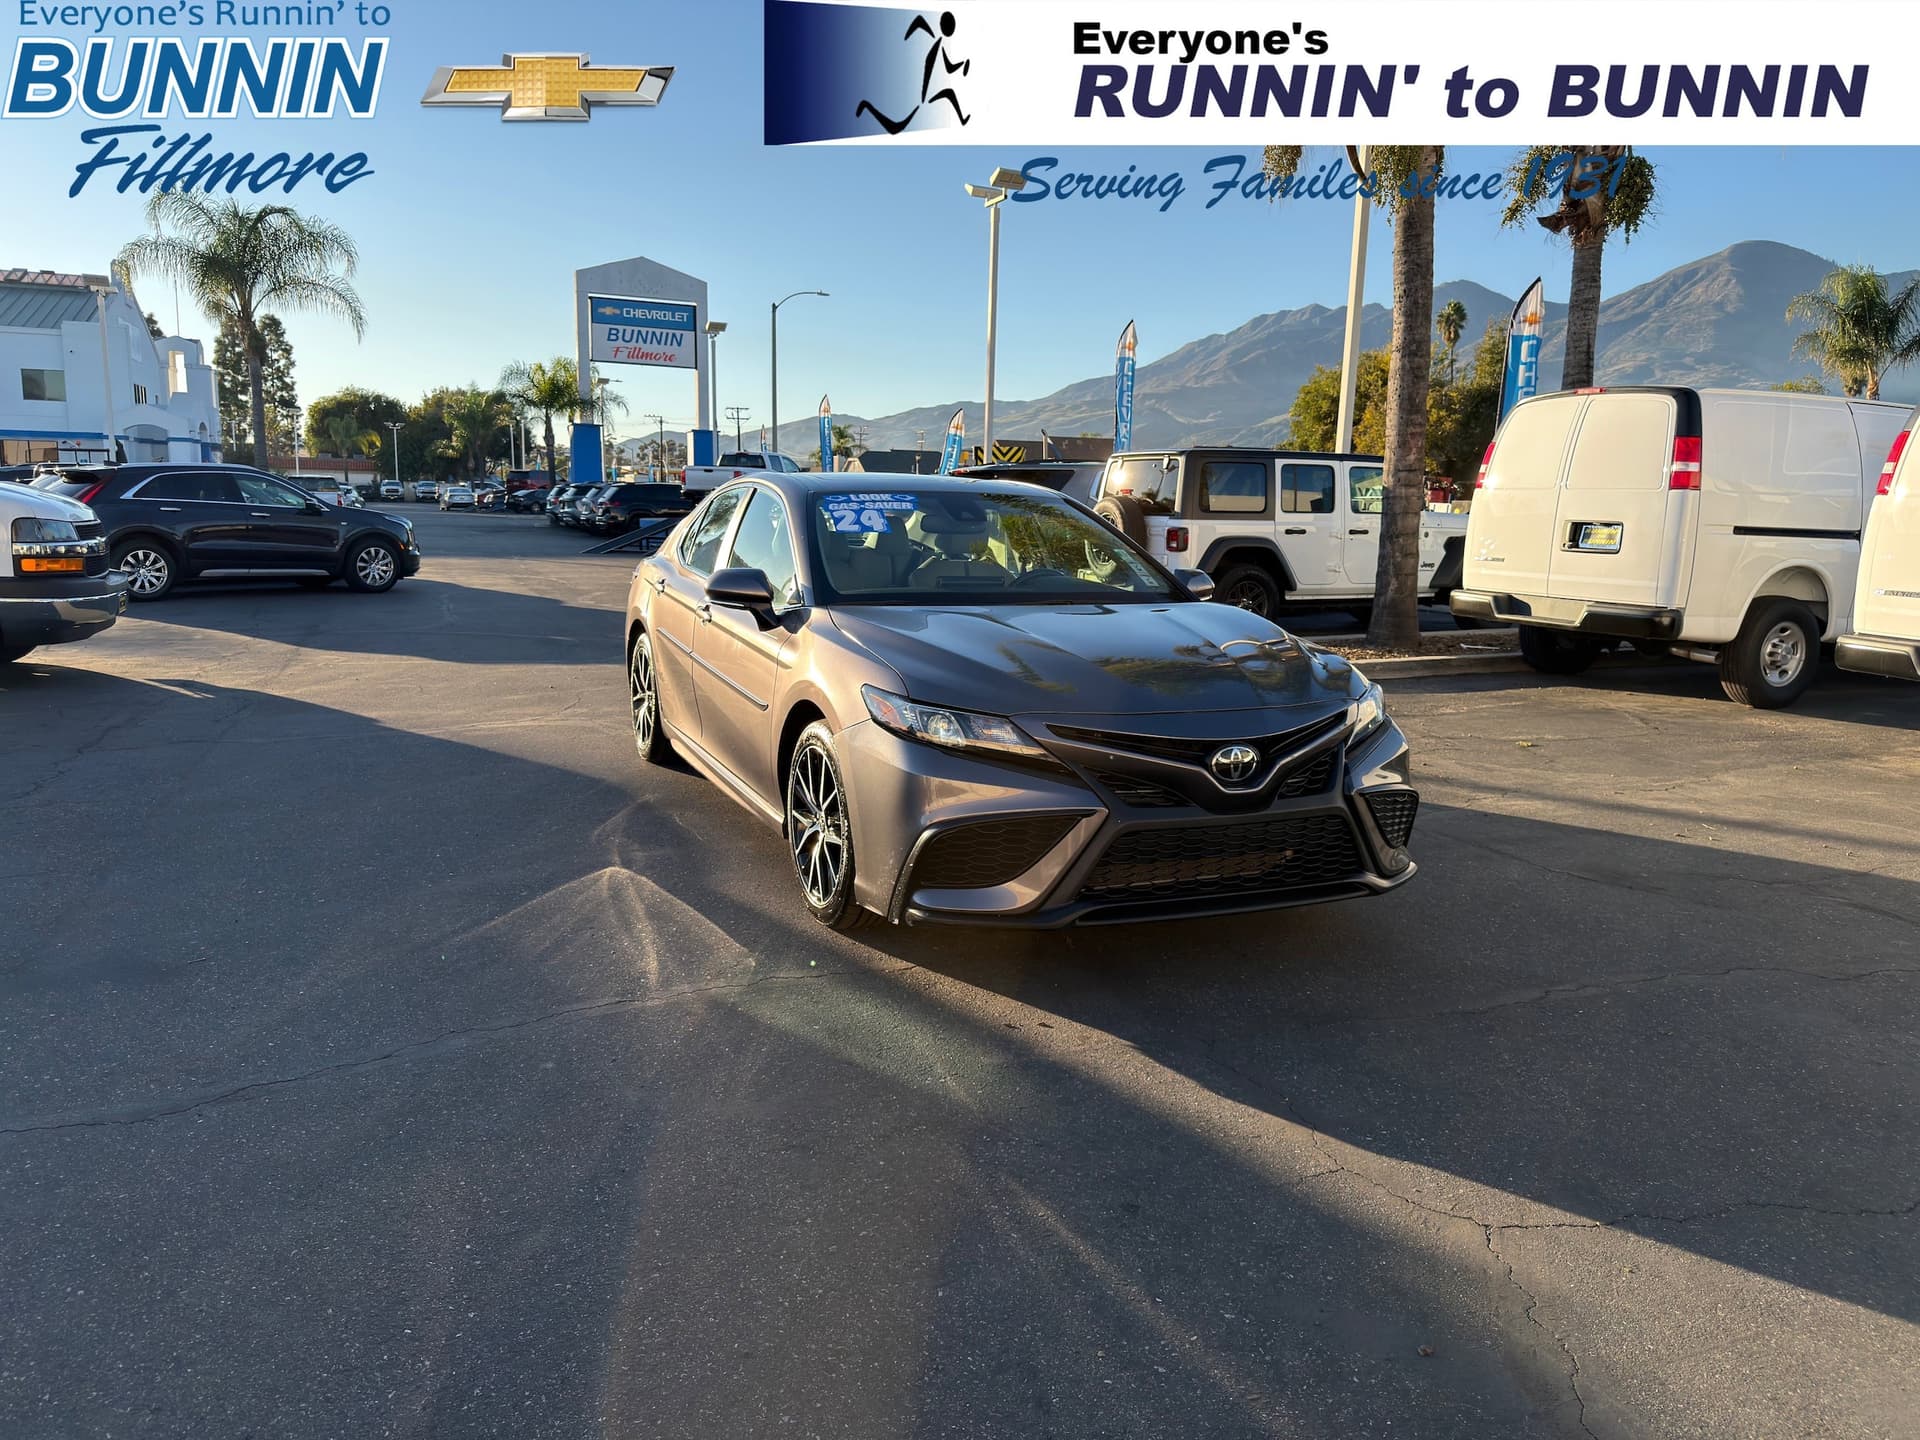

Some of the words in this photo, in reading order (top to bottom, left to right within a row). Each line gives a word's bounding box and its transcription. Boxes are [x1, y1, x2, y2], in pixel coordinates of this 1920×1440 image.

[623, 307, 688, 322] CHEVROLET
[606, 327, 684, 347] BUNNIN
[611, 346, 678, 362] Fillmore
[848, 493, 893, 502] LOOK
